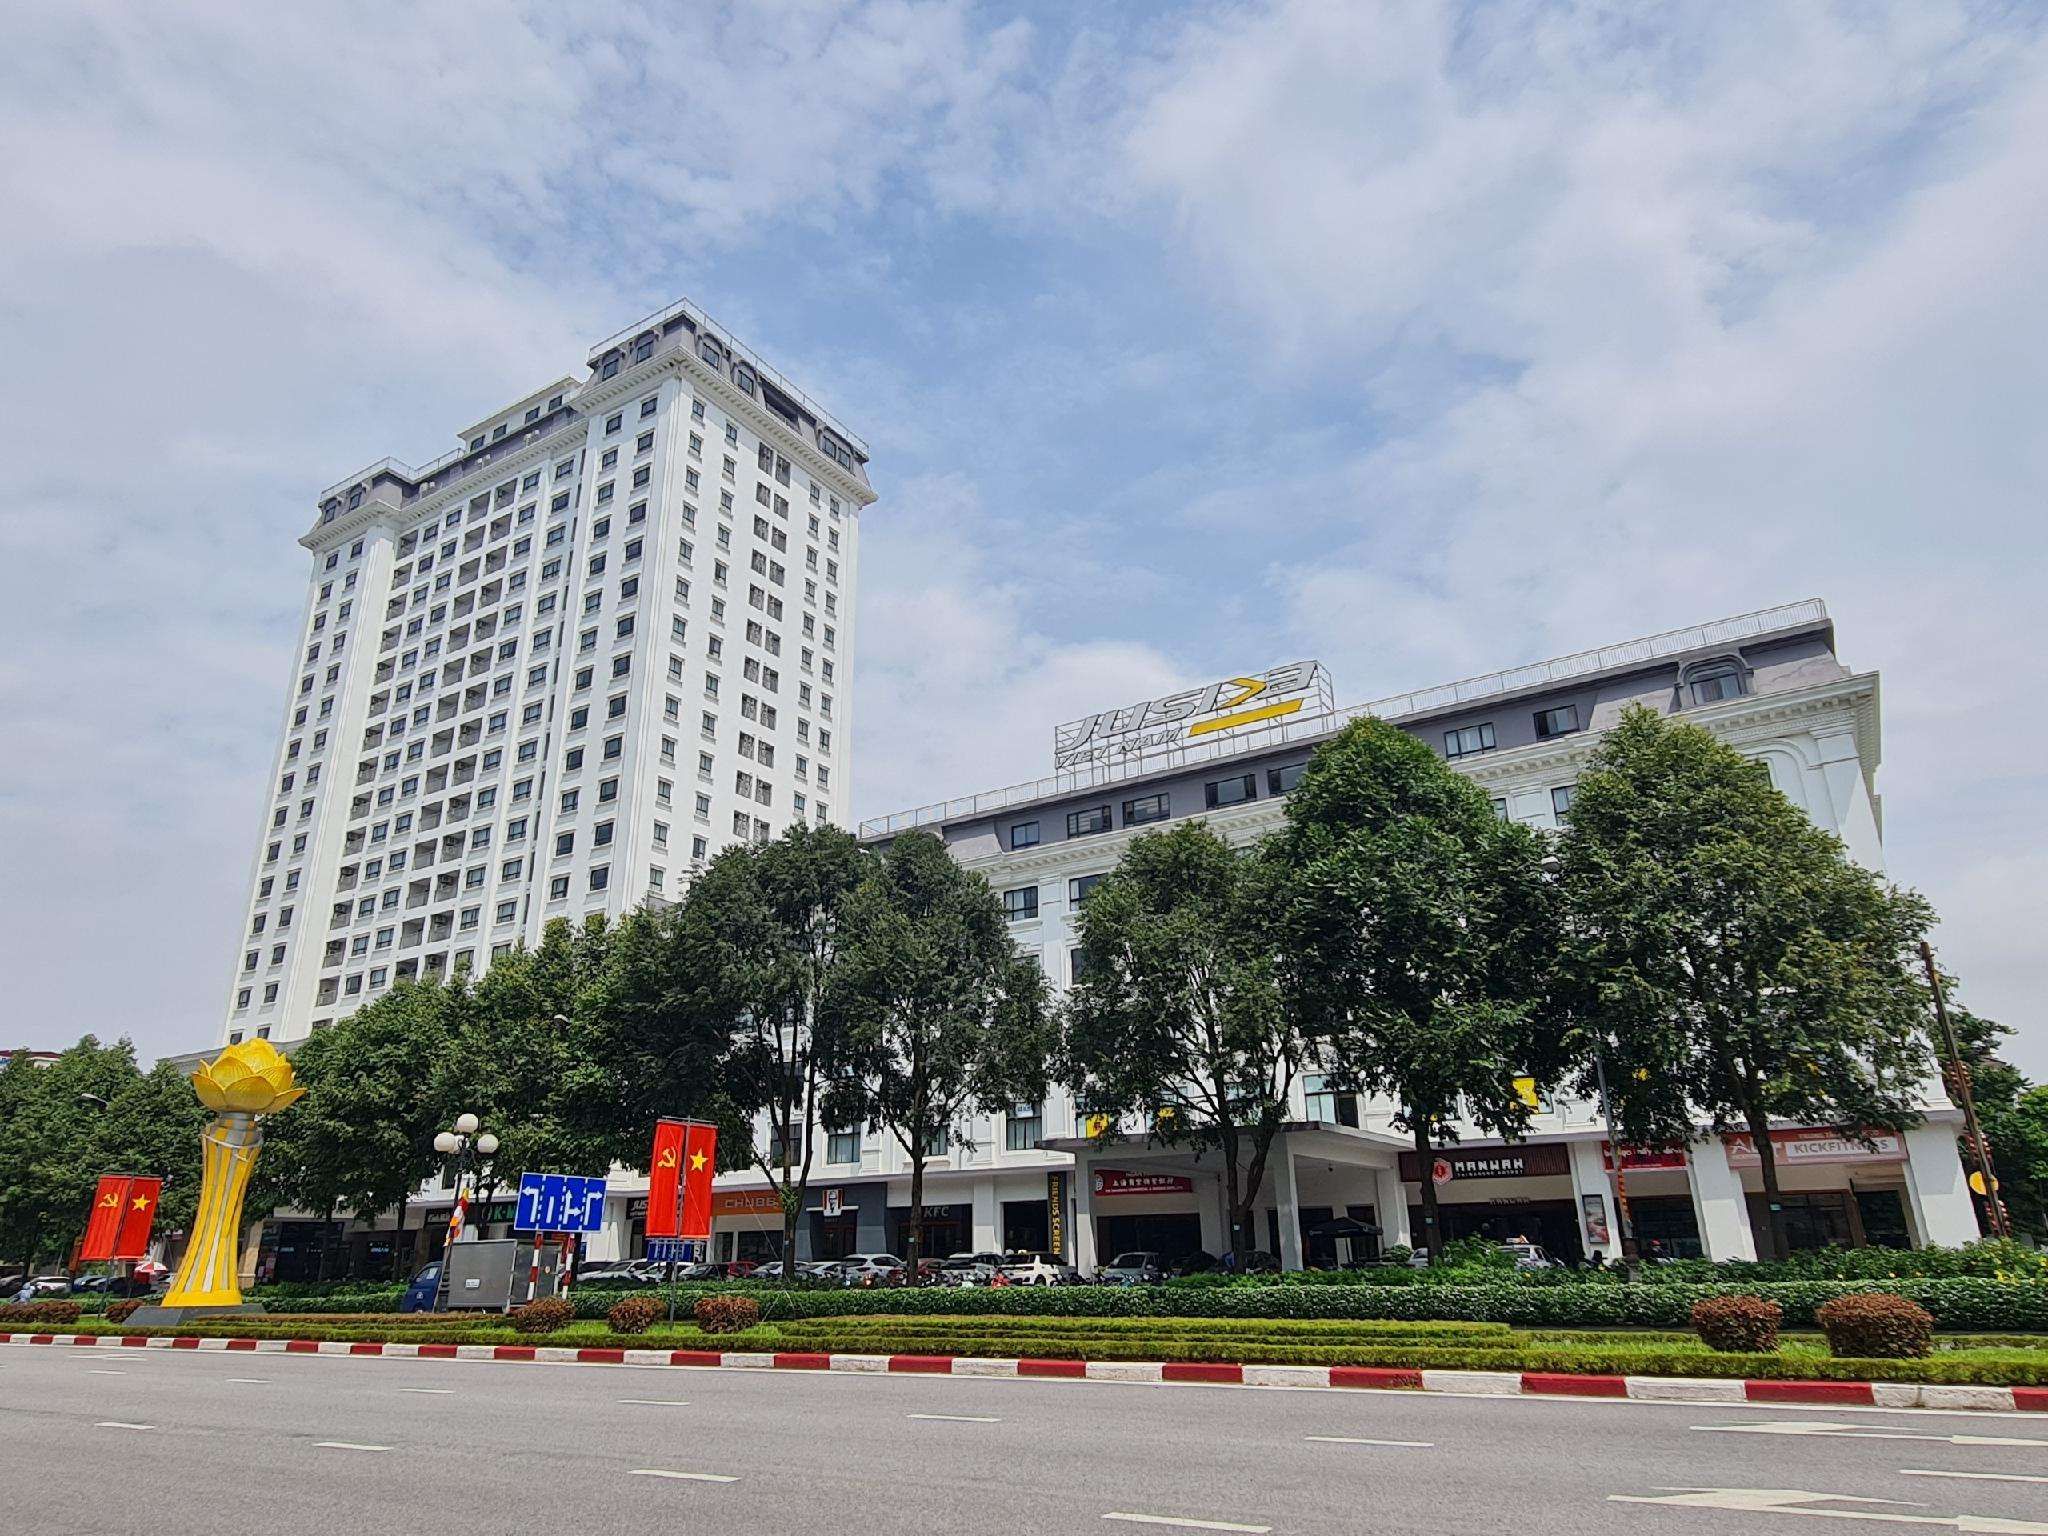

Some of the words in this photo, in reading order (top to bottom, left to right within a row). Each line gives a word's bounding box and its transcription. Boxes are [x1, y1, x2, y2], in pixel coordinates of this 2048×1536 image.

[1454, 1157, 1524, 1172] MANWAH
[1051, 1175, 1060, 1216] FRIENDS
[631, 1199, 649, 1211] JUS
[923, 1206, 951, 1218] KFC
[1052, 1217, 1062, 1255] SCREEN
